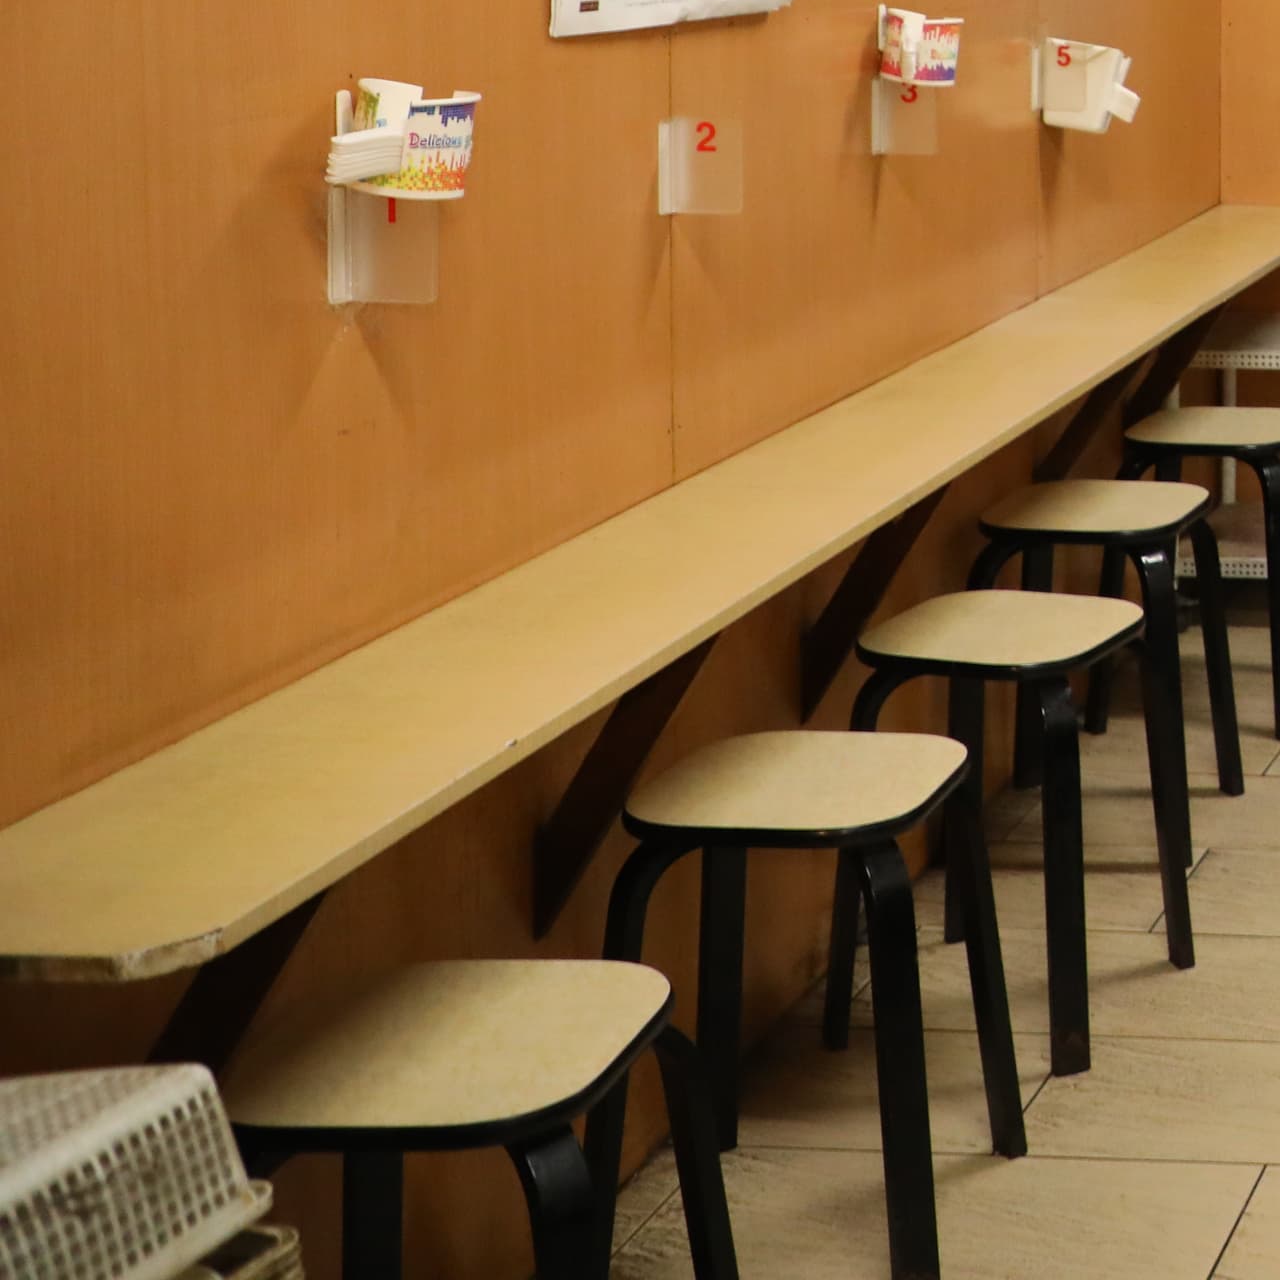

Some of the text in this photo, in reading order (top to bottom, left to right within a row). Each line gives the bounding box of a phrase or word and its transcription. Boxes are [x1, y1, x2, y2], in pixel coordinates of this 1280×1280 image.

[1056, 45, 1071, 67] 5
[408, 131, 462, 150] Delicious
[695, 121, 717, 152] 2
